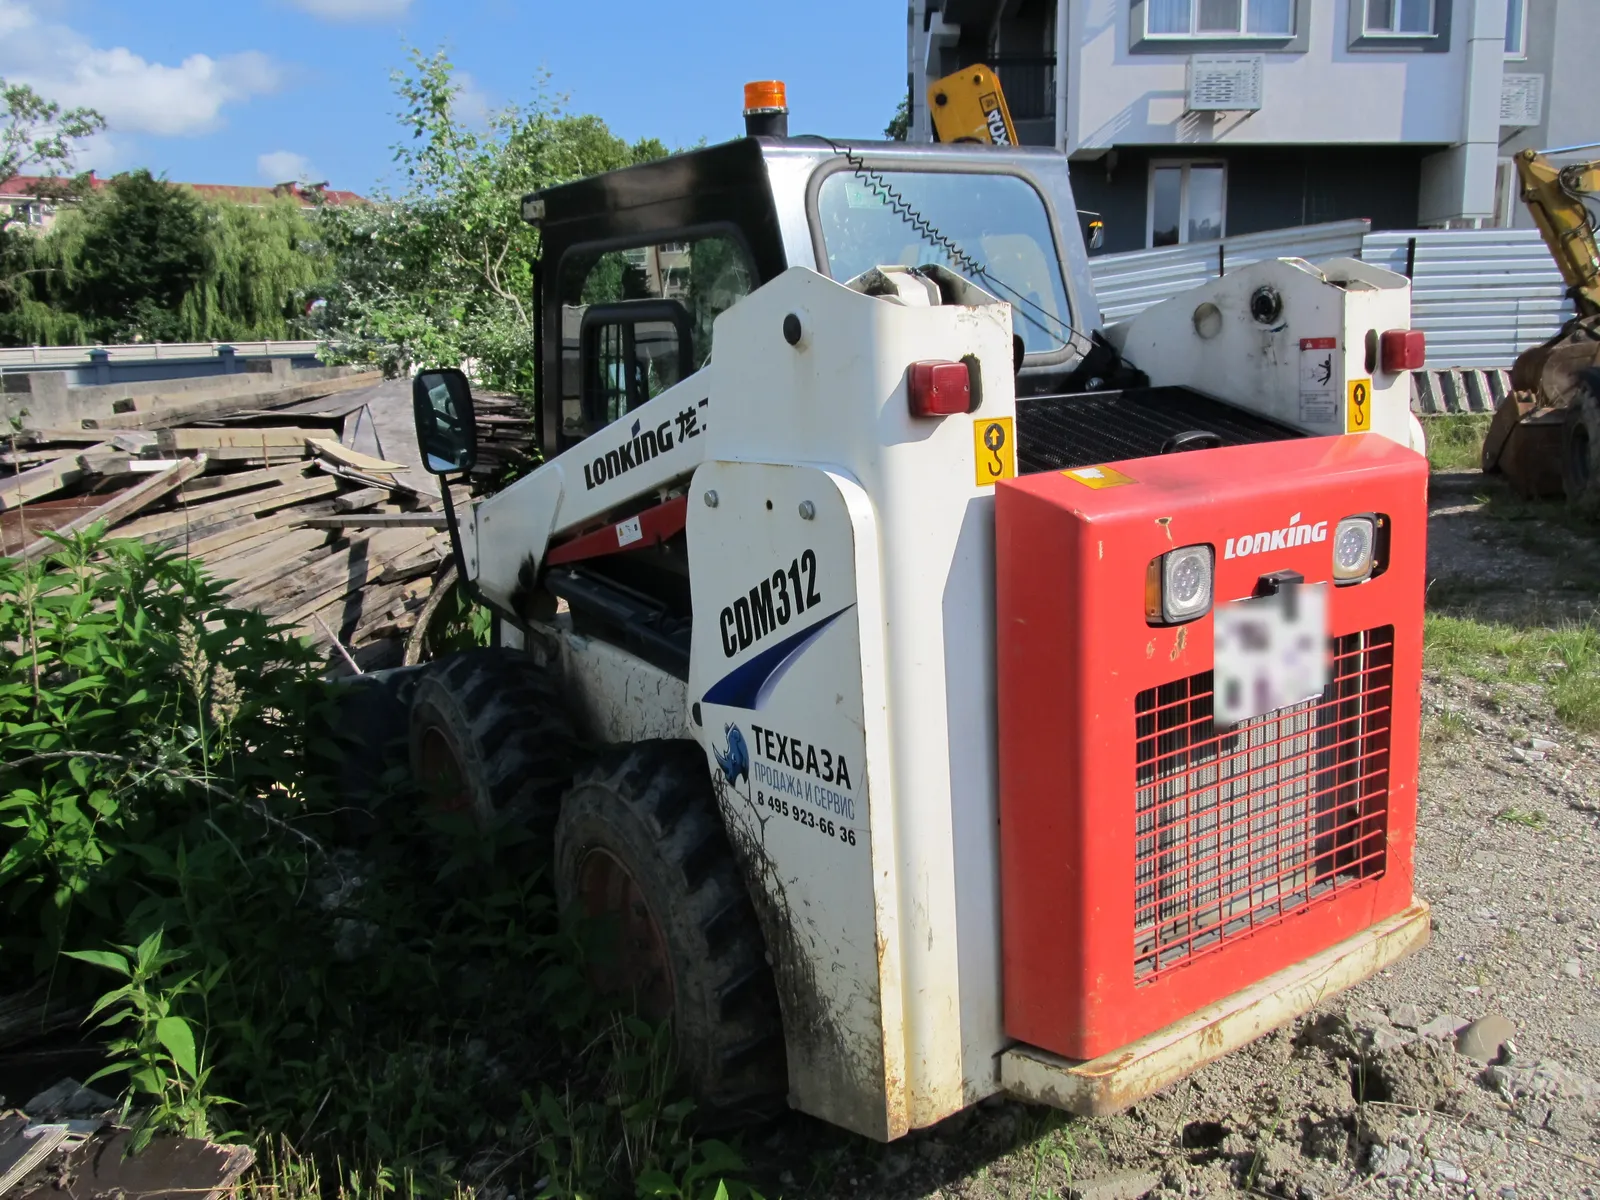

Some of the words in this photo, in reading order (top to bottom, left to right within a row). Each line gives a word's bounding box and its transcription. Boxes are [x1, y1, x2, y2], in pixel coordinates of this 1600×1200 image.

[719, 548, 822, 658] CDM312
[751, 724, 852, 790] ТЕХБАЗА
[754, 761, 803, 800] ПРОДАЖА
[805, 780, 813, 803] И
[814, 785, 855, 821] СЕРВИС
[757, 790, 765, 806] 8
[767, 795, 789, 817] 495
[792, 805, 835, 838] 923-66
[839, 826, 856, 847] 36
